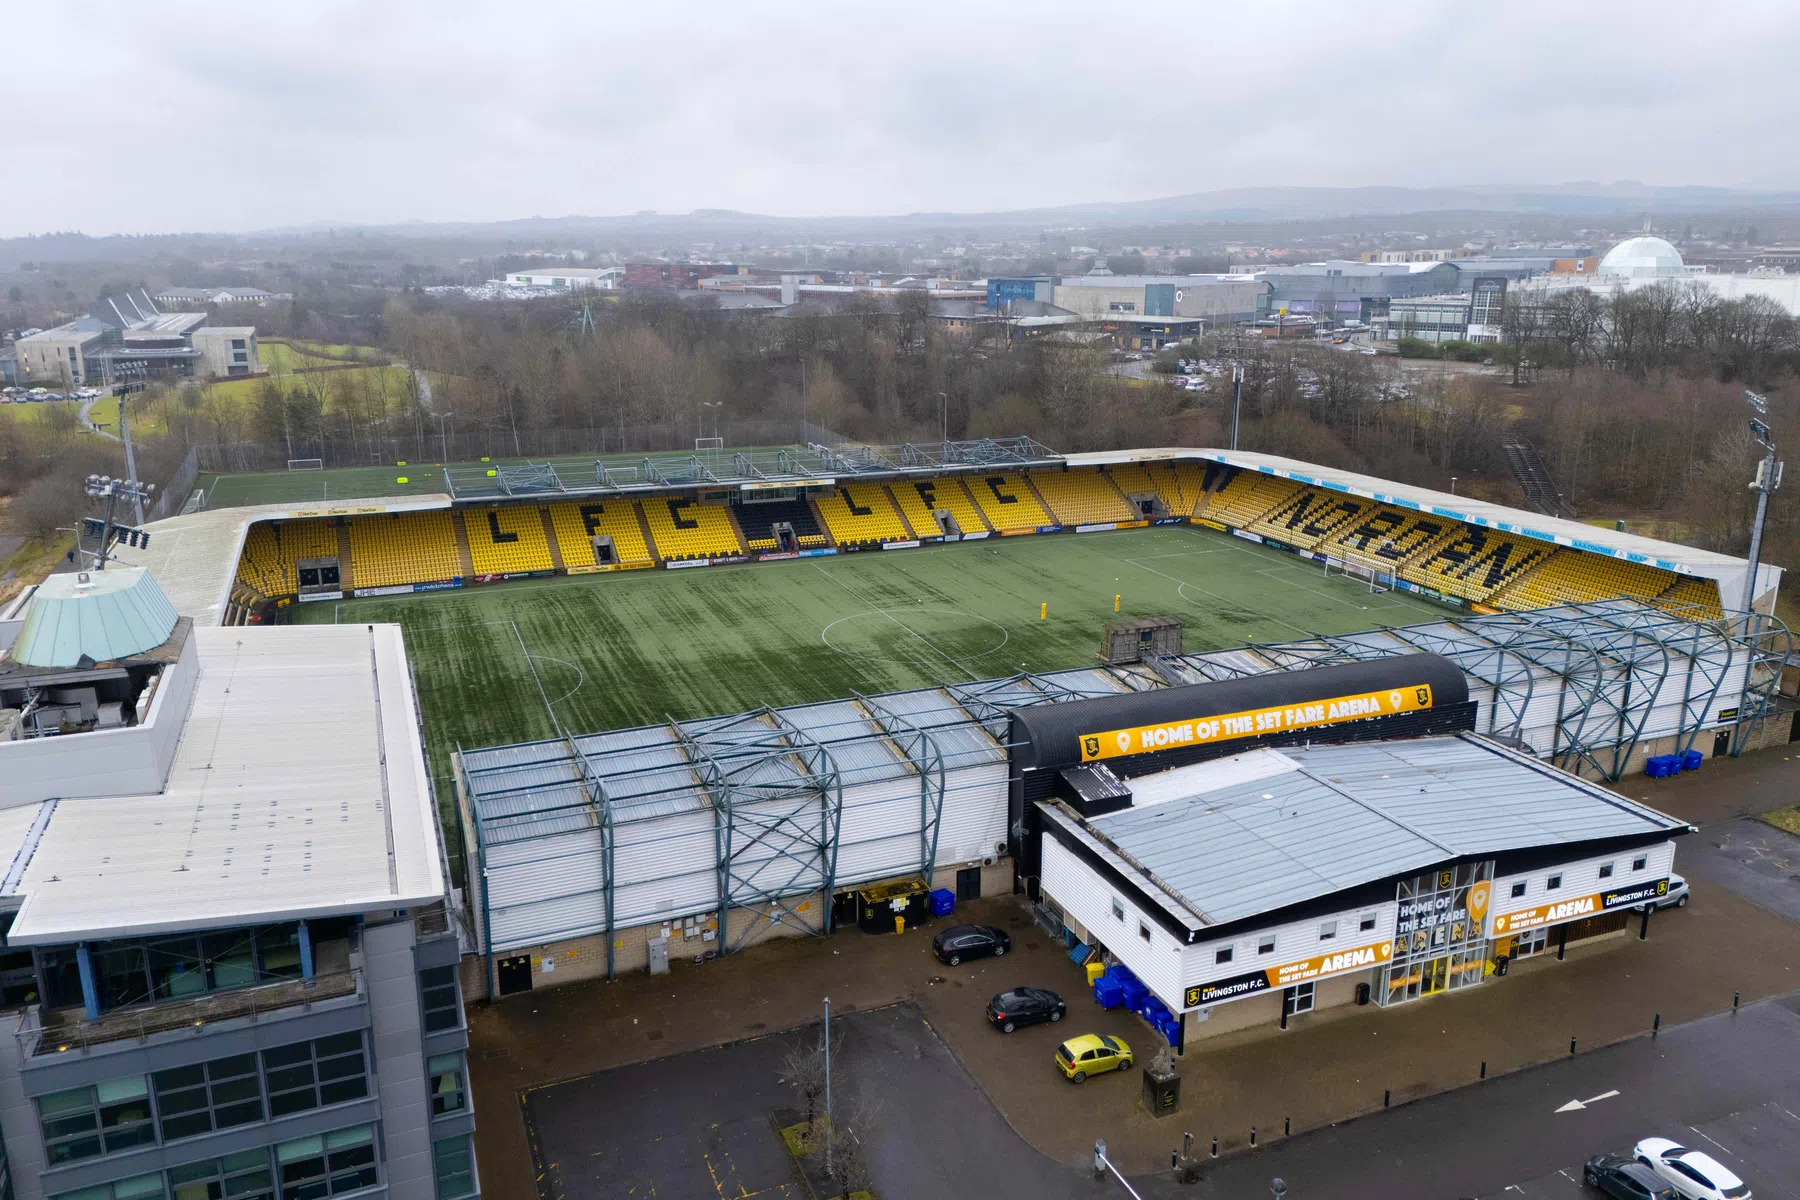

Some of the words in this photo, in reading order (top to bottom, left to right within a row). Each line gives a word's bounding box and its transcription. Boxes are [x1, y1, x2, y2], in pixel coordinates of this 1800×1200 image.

[1142, 725, 1194, 748] HOME
[1196, 721, 1220, 739] OF
[1222, 716, 1253, 734] THE
[1255, 712, 1282, 731] SET
[1285, 704, 1324, 726] FARE
[1328, 696, 1380, 720] ARENA
[1400, 901, 1433, 917] HOME
[1435, 897, 1451, 910] OF
[1606, 891, 1643, 906] LIVINGSTON
[1644, 888, 1656, 897] F.C.
[1510, 911, 1528, 921] HOME
[1528, 910, 1537, 918] OF
[1545, 898, 1595, 921] ARENA
[1399, 919, 1419, 932] THE
[1420, 914, 1438, 928] SET
[1439, 908, 1466, 923] FARE
[1509, 922, 1520, 930] THE
[1520, 919, 1530, 927] SET
[1530, 916, 1544, 926] FARE
[1395, 920, 1483, 954] ARENA
[1279, 964, 1299, 974] HOME
[1300, 962, 1309, 970] OF
[1320, 948, 1375, 974] ARENA
[1279, 974, 1290, 983] THE
[1291, 972, 1302, 981] SET
[1302, 969, 1318, 978] FARE
[1202, 982, 1248, 1000] LIVINGSTON
[1249, 979, 1265, 989] F.C.
